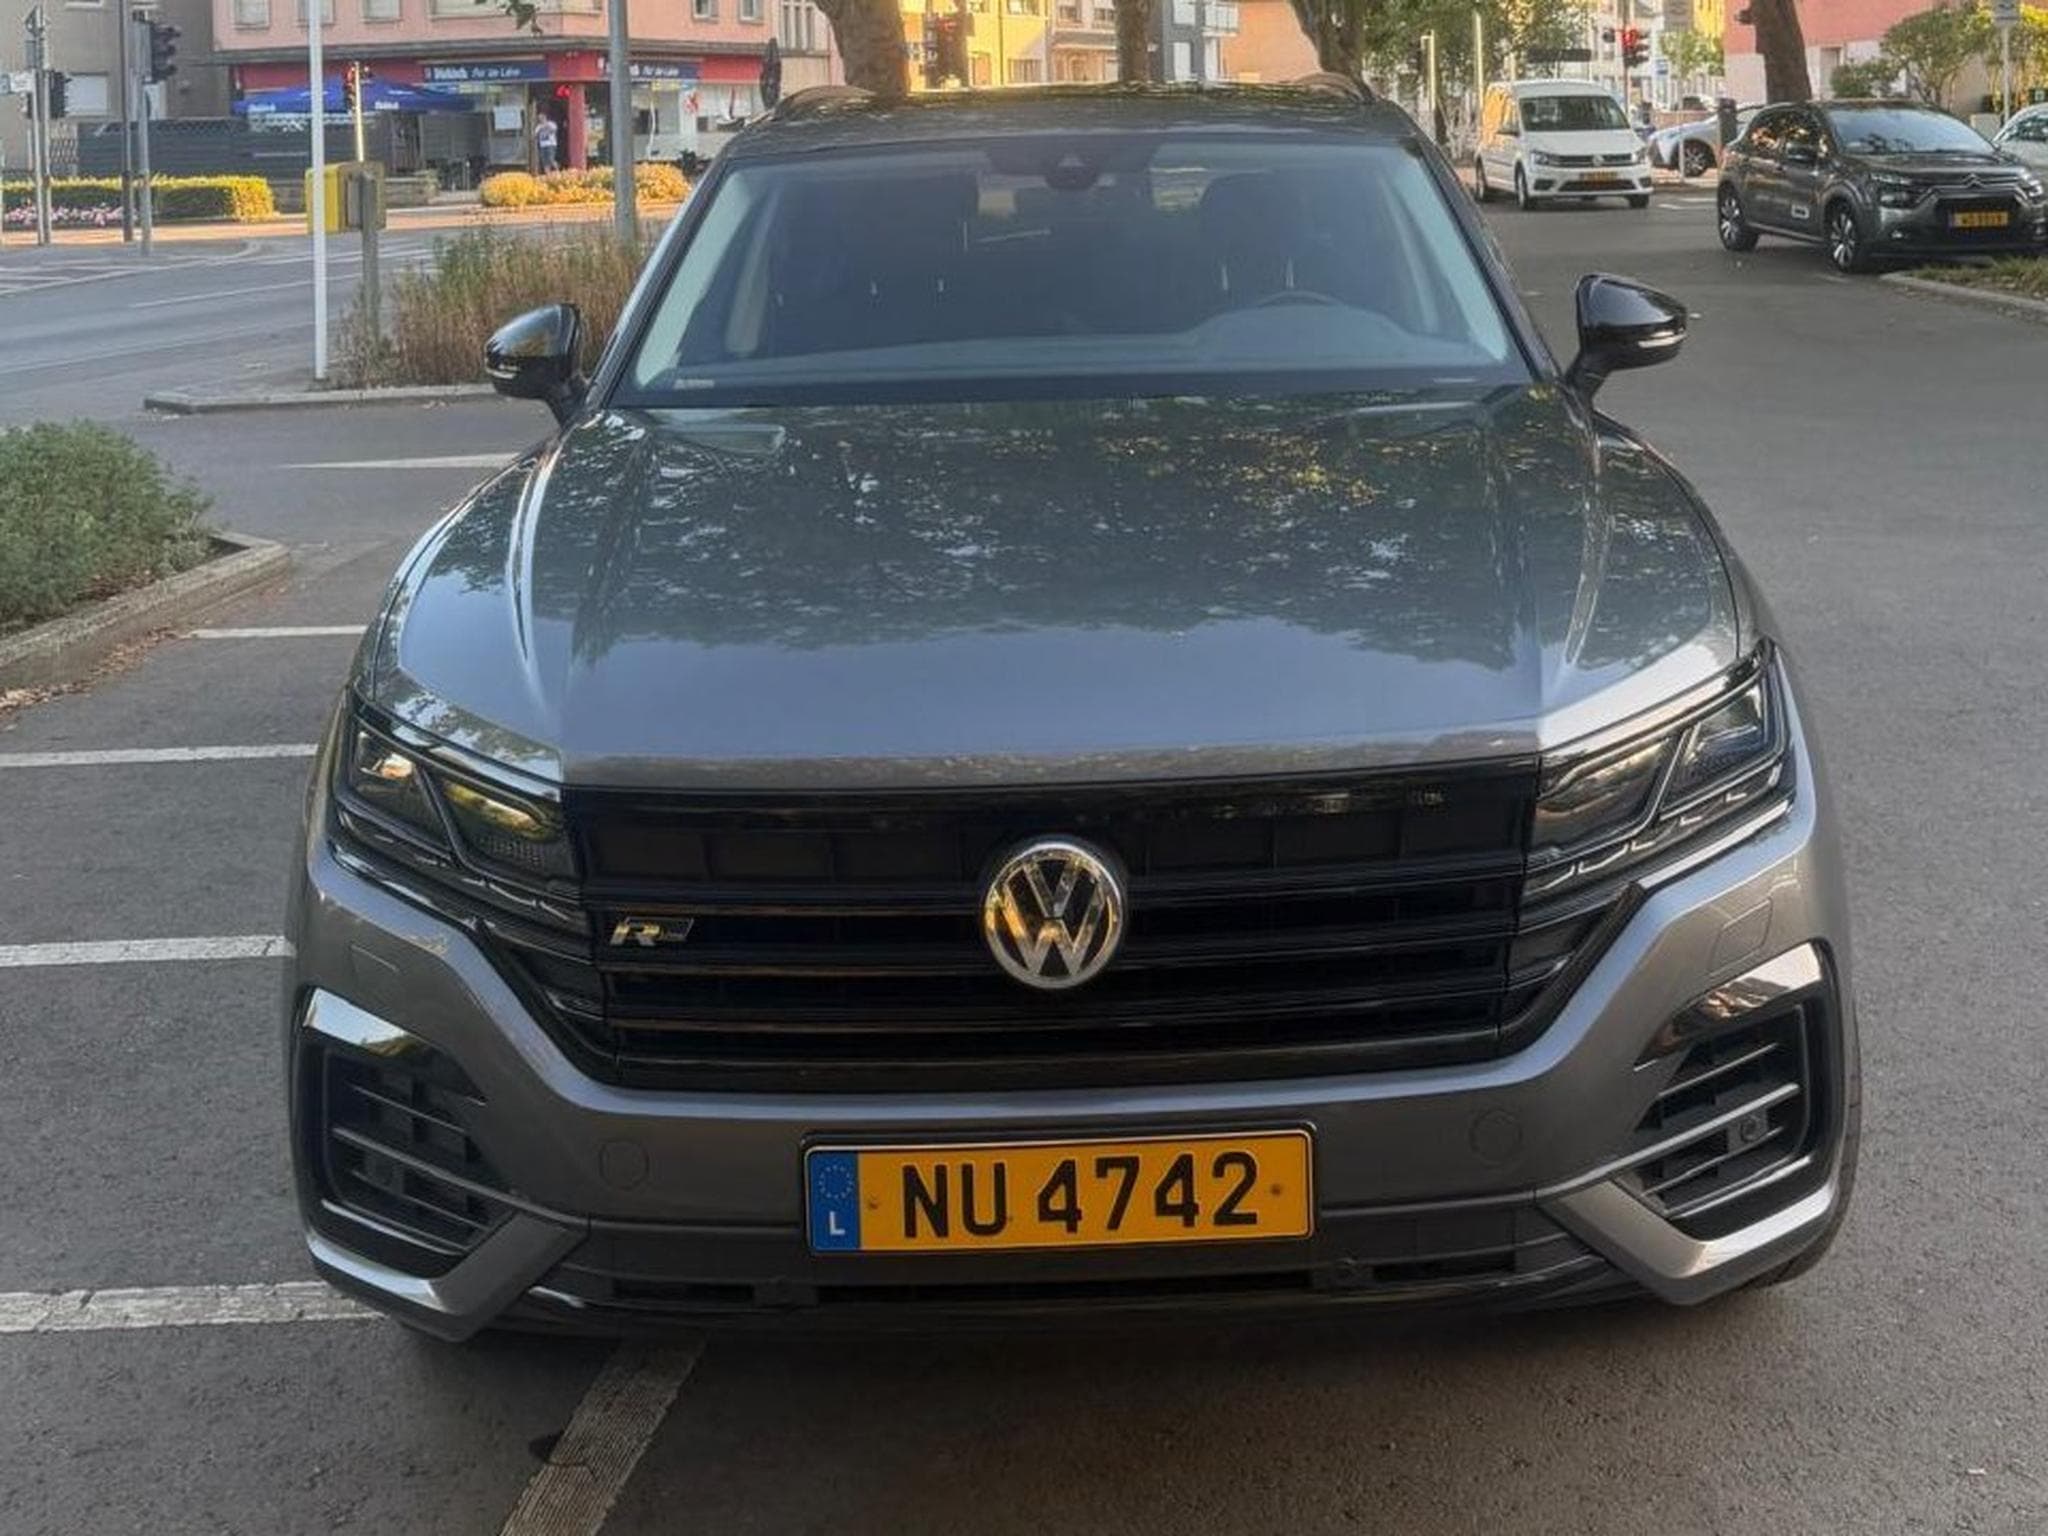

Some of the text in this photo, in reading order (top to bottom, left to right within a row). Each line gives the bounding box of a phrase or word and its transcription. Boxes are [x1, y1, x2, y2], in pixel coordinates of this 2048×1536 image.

[1000, 855, 1106, 978] VW
[828, 1211, 846, 1237] L
[902, 1150, 1258, 1239] NU 4742
